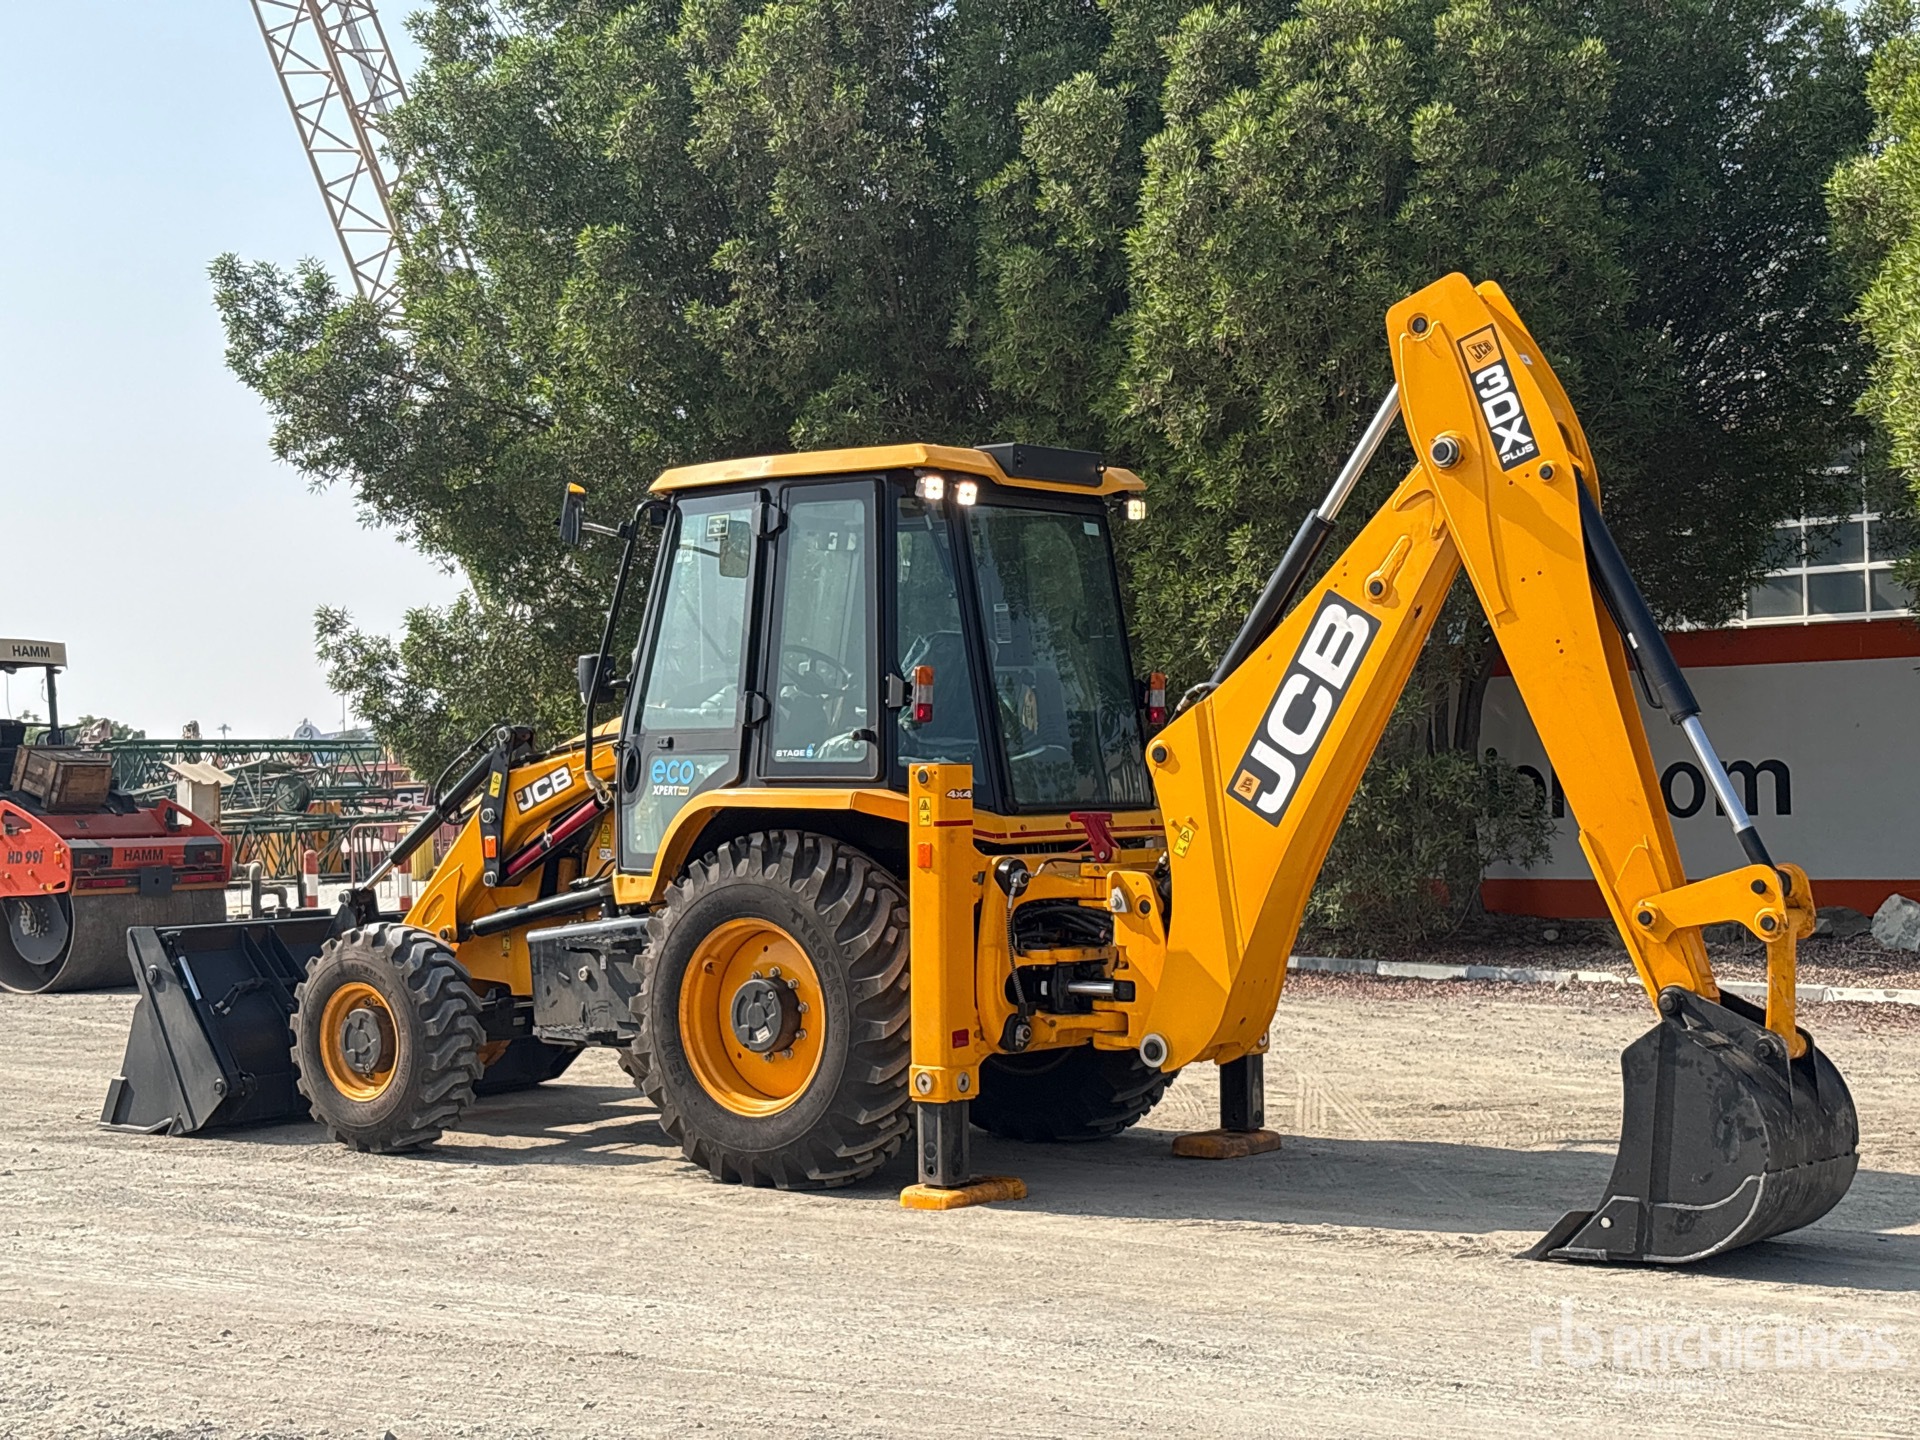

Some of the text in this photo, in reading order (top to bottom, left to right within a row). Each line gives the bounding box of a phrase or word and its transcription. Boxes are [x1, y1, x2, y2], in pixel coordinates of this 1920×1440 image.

[1471, 341, 1493, 360] JCB
[1475, 364, 1533, 455] 3DX
[1501, 443, 1535, 464] PLUS
[11, 645, 51, 658] HAMM
[1250, 603, 1370, 814] JCB
[775, 749, 806, 757] STAGE
[651, 758, 695, 785] eco
[518, 766, 573, 811] JCB
[652, 785, 679, 796] XPERT
[946, 789, 973, 799] 4x4
[7, 850, 43, 865] HD 99i
[123, 848, 164, 862] HAMM
